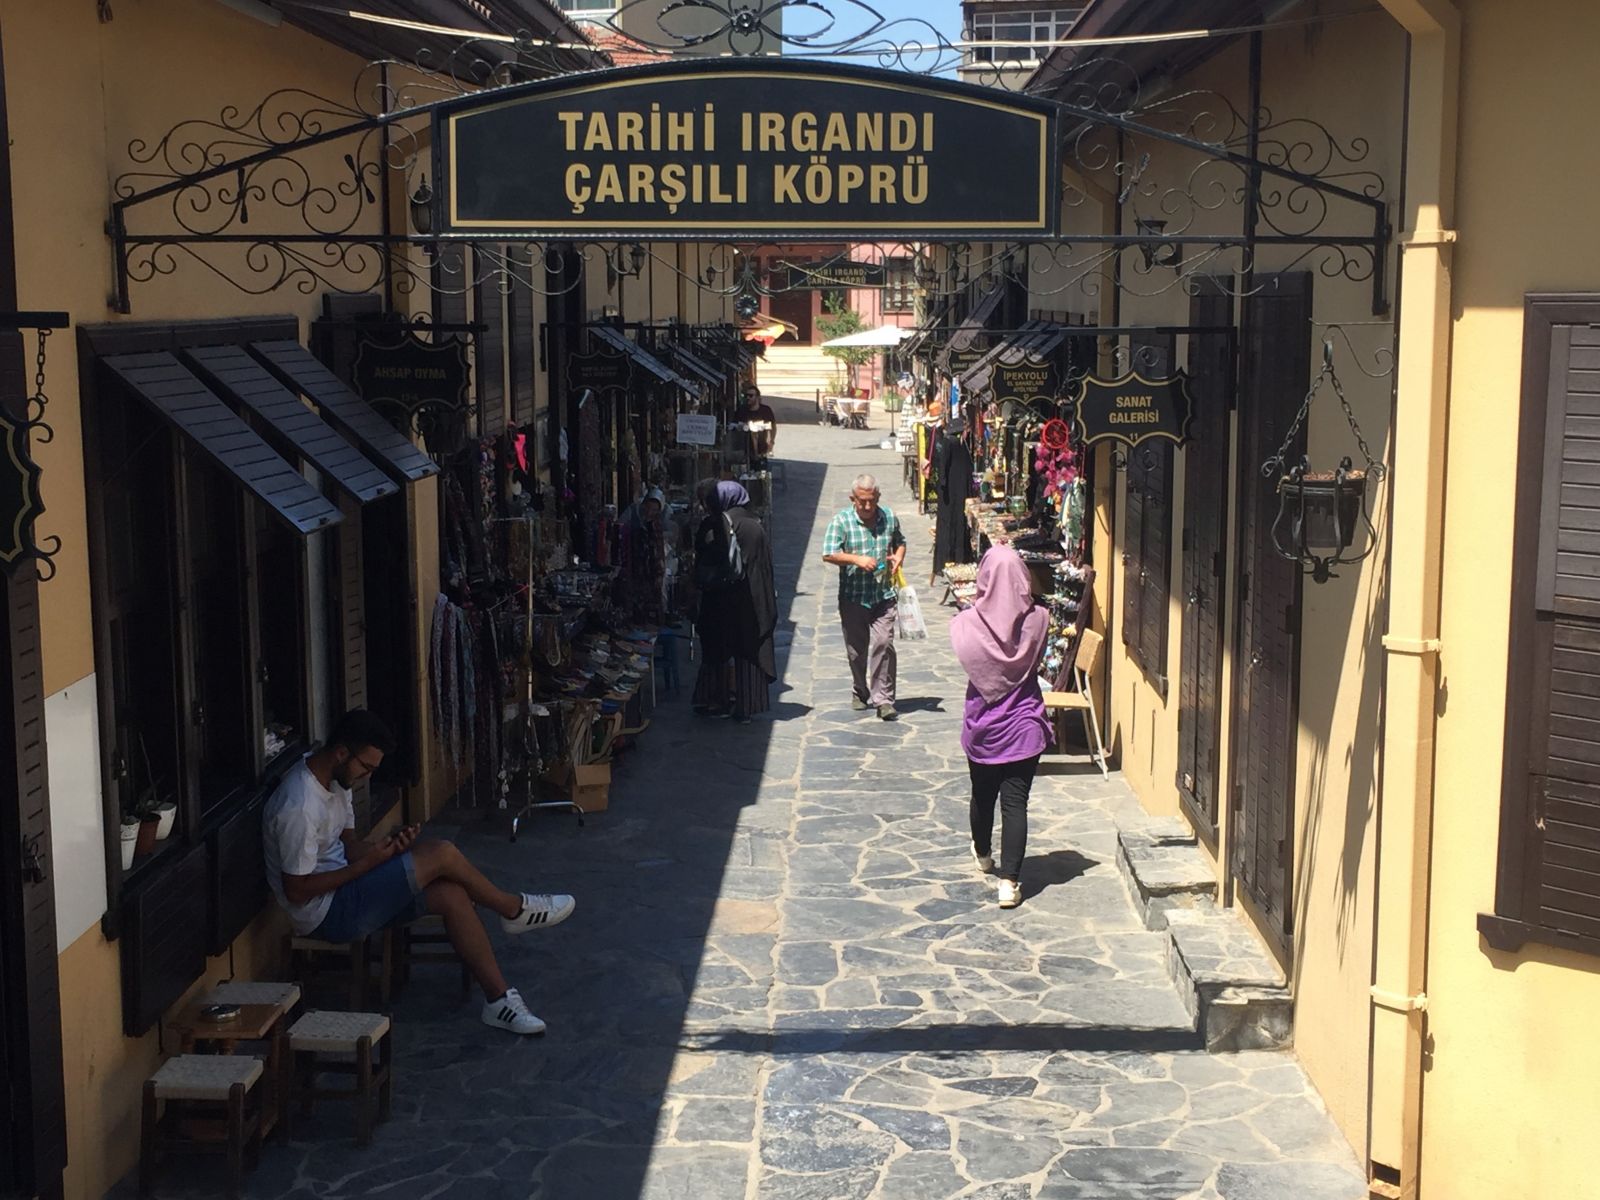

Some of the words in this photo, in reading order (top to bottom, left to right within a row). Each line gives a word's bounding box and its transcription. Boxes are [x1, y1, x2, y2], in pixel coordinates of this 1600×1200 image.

[559, 103, 714, 150] TARİHİ
[743, 112, 933, 151] IRGANDI
[566, 164, 746, 213] ÇARŞILI
[775, 156, 927, 203] KÖPRÜ
[1273, 277, 1279, 289] 1
[414, 367, 447, 379] OYMA
[1003, 370, 1048, 380] İPEKYOLU
[1115, 396, 1152, 407] SANAT
[1108, 409, 1159, 424] GALERİSİ
[1129, 432, 1138, 441] 11
